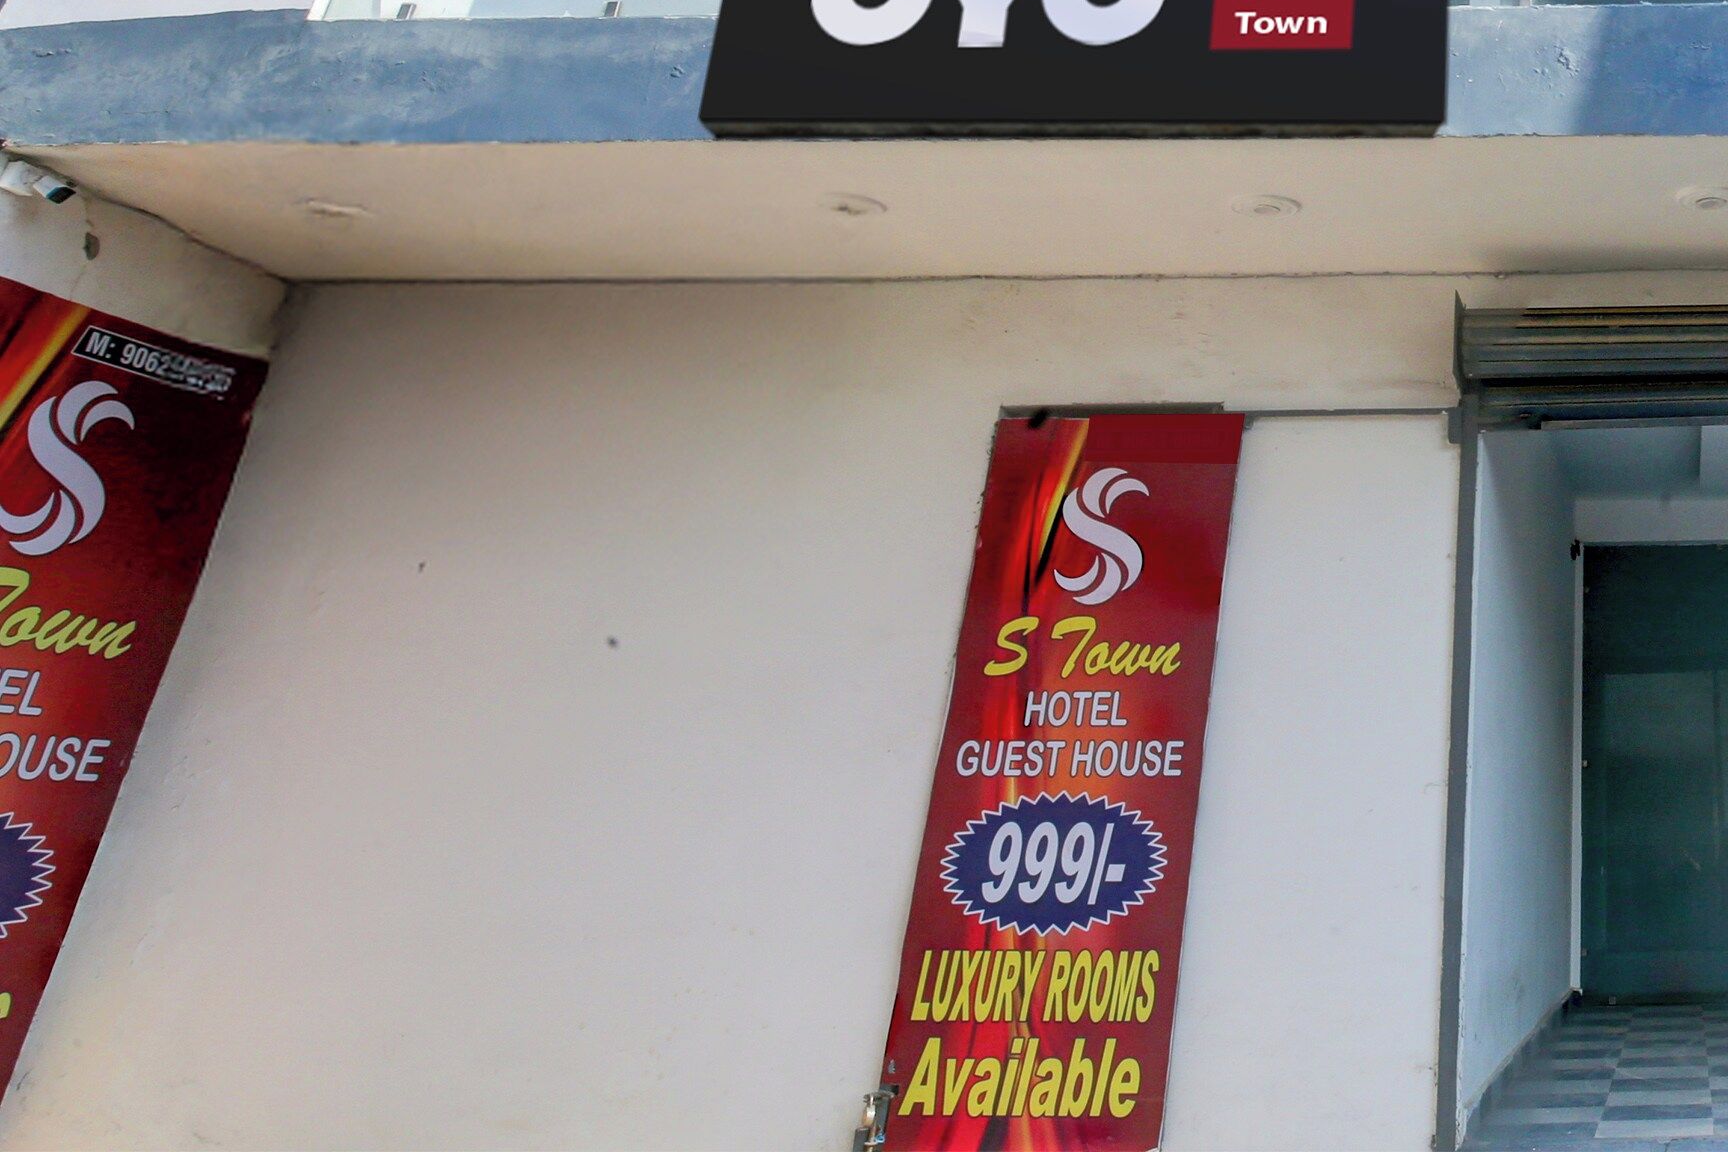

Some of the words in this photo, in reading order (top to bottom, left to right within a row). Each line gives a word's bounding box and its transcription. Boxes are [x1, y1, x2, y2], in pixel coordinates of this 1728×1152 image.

[1235, 12, 1328, 35] Town
[84, 330, 117, 359] M:
[983, 616, 1040, 676] S
[1050, 616, 1182, 677] Town
[1024, 690, 1128, 728] HOTEL
[0, 731, 111, 783] OUSE
[956, 740, 1067, 777] GUEST
[1071, 740, 1184, 777] HOUSE
[981, 821, 1127, 906] 999/-
[910, 949, 1042, 1023] LUXURY
[1044, 949, 1161, 1023] ROOMS
[897, 1038, 1141, 1118] Available
